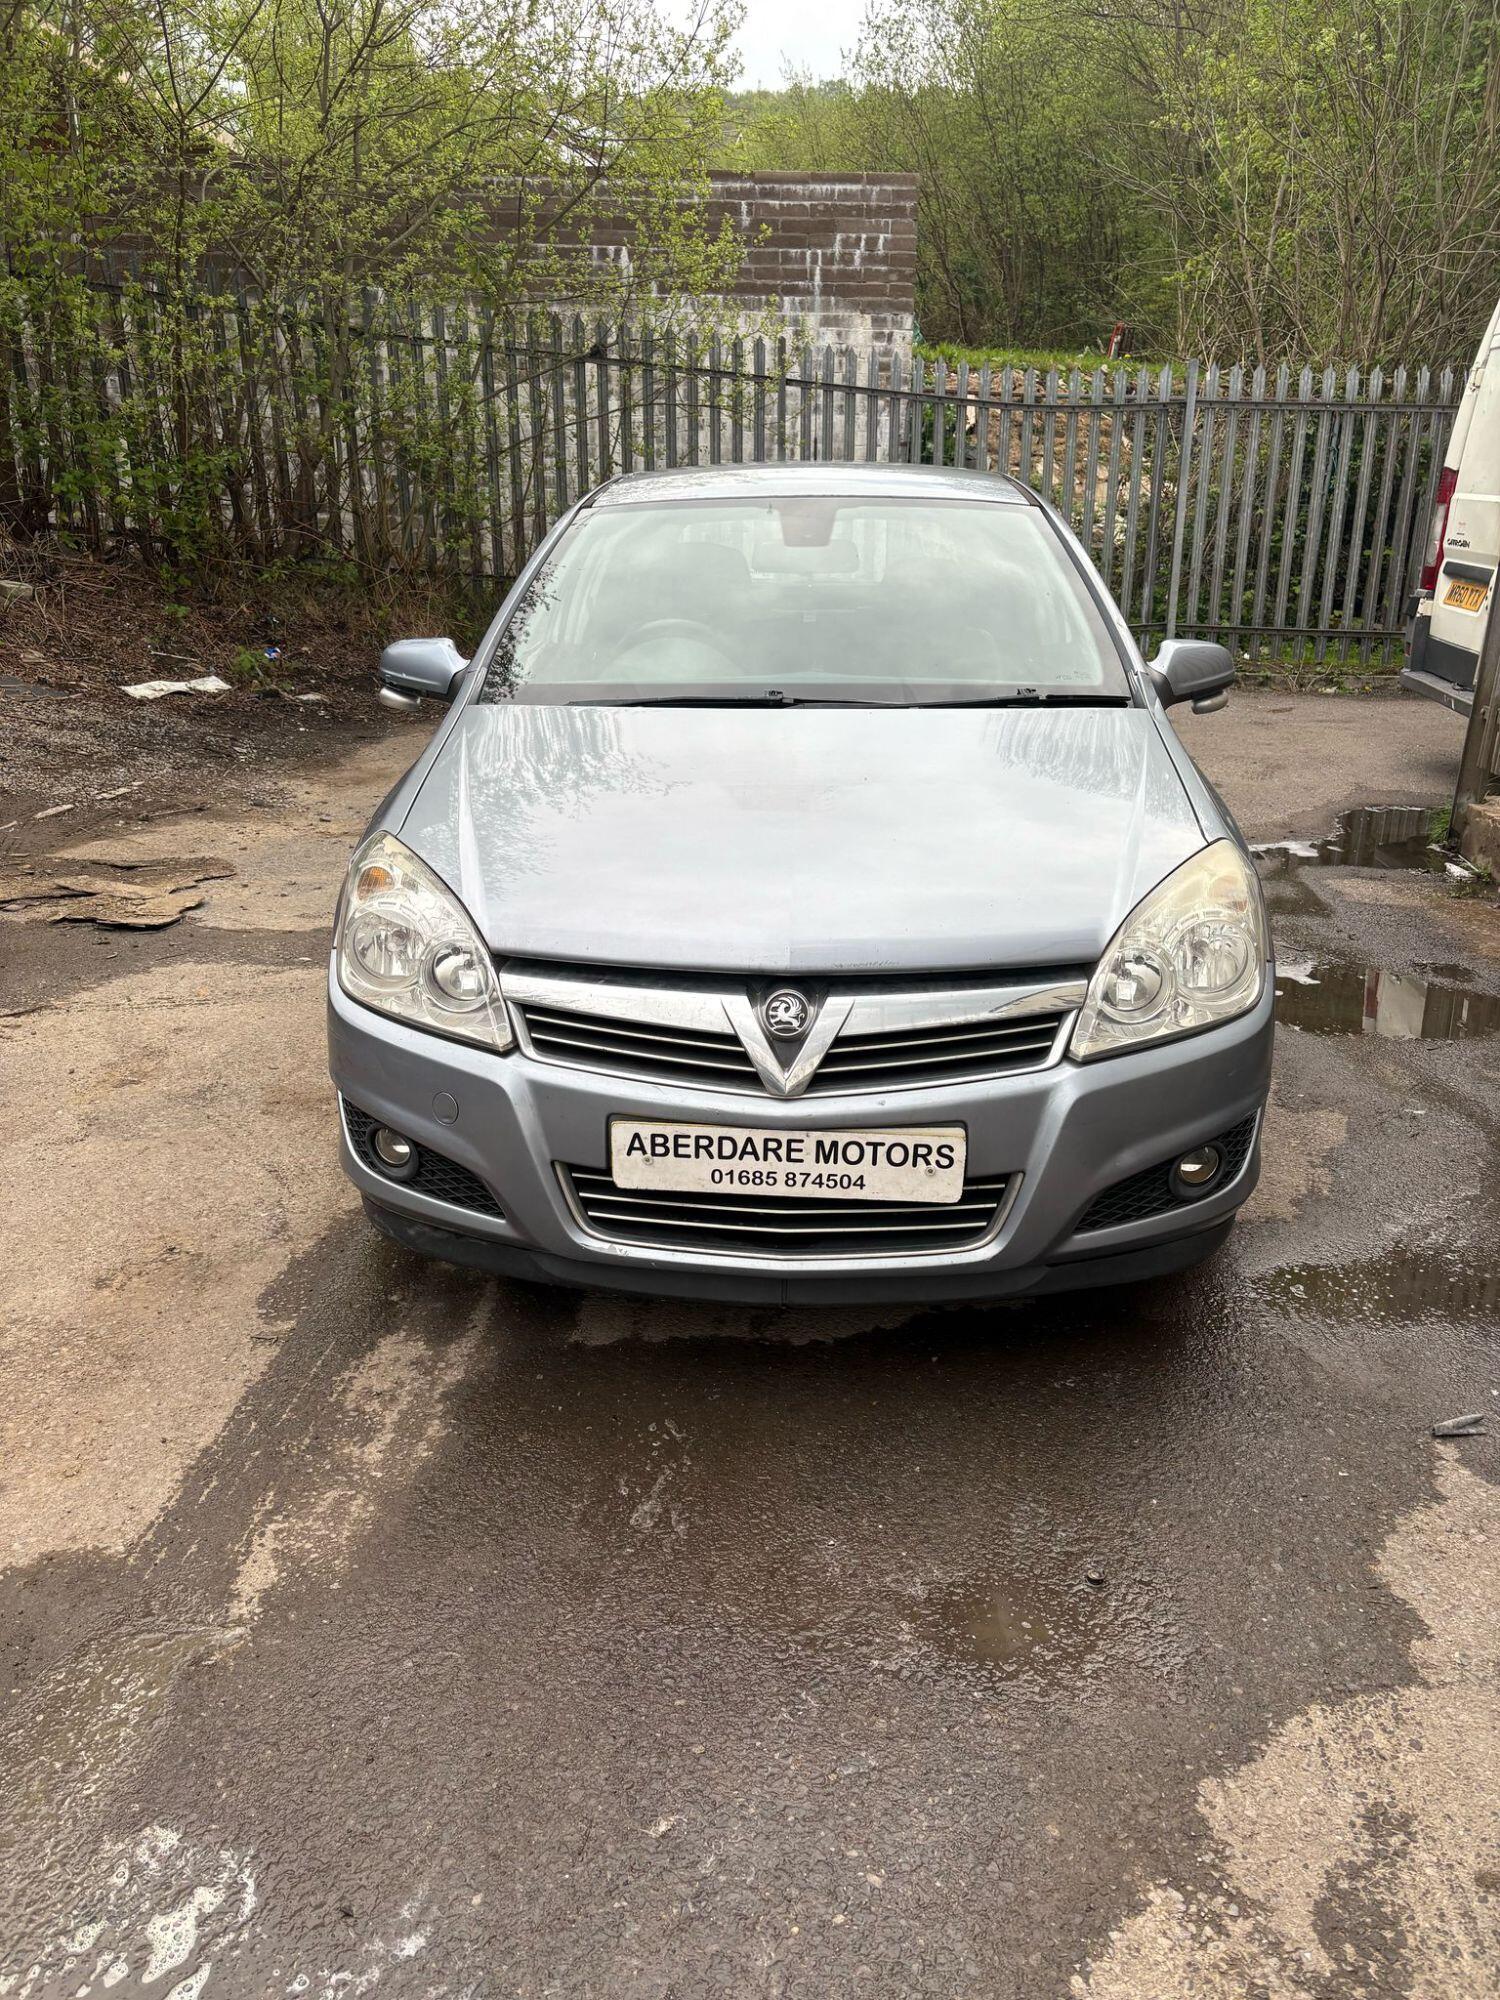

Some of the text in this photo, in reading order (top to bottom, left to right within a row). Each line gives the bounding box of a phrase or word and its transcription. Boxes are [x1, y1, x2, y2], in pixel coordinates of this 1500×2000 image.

[627, 1132, 955, 1170] ABERDARE MOTORS
[711, 1169, 866, 1190] 01685 874504
